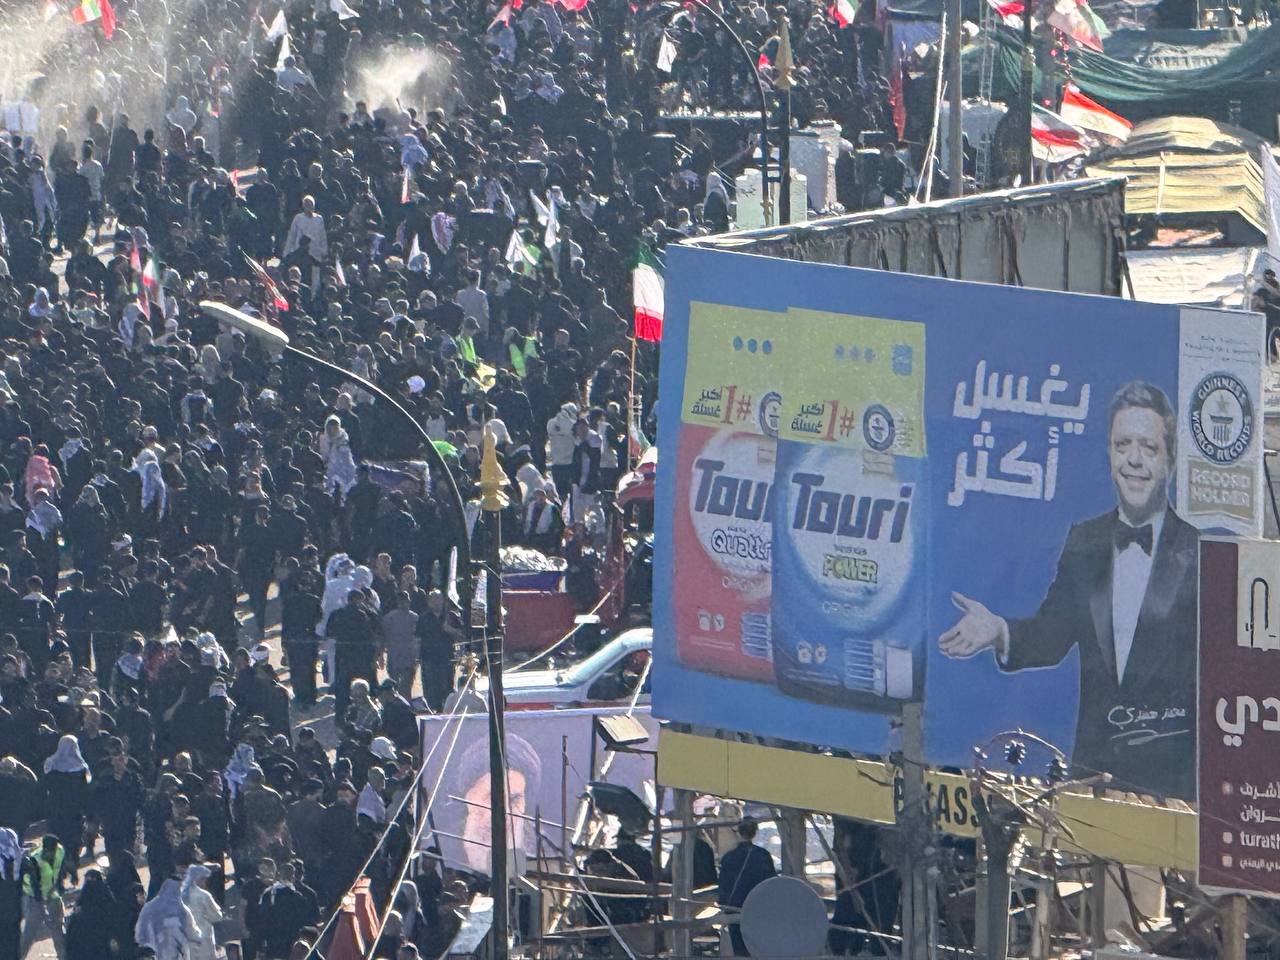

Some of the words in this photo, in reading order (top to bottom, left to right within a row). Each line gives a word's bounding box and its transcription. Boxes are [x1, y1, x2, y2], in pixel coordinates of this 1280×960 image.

[952, 359, 1091, 435] يغسل
[947, 420, 1060, 507] أكثر
[792, 472, 913, 544] Touri
[823, 552, 879, 584] POWER
